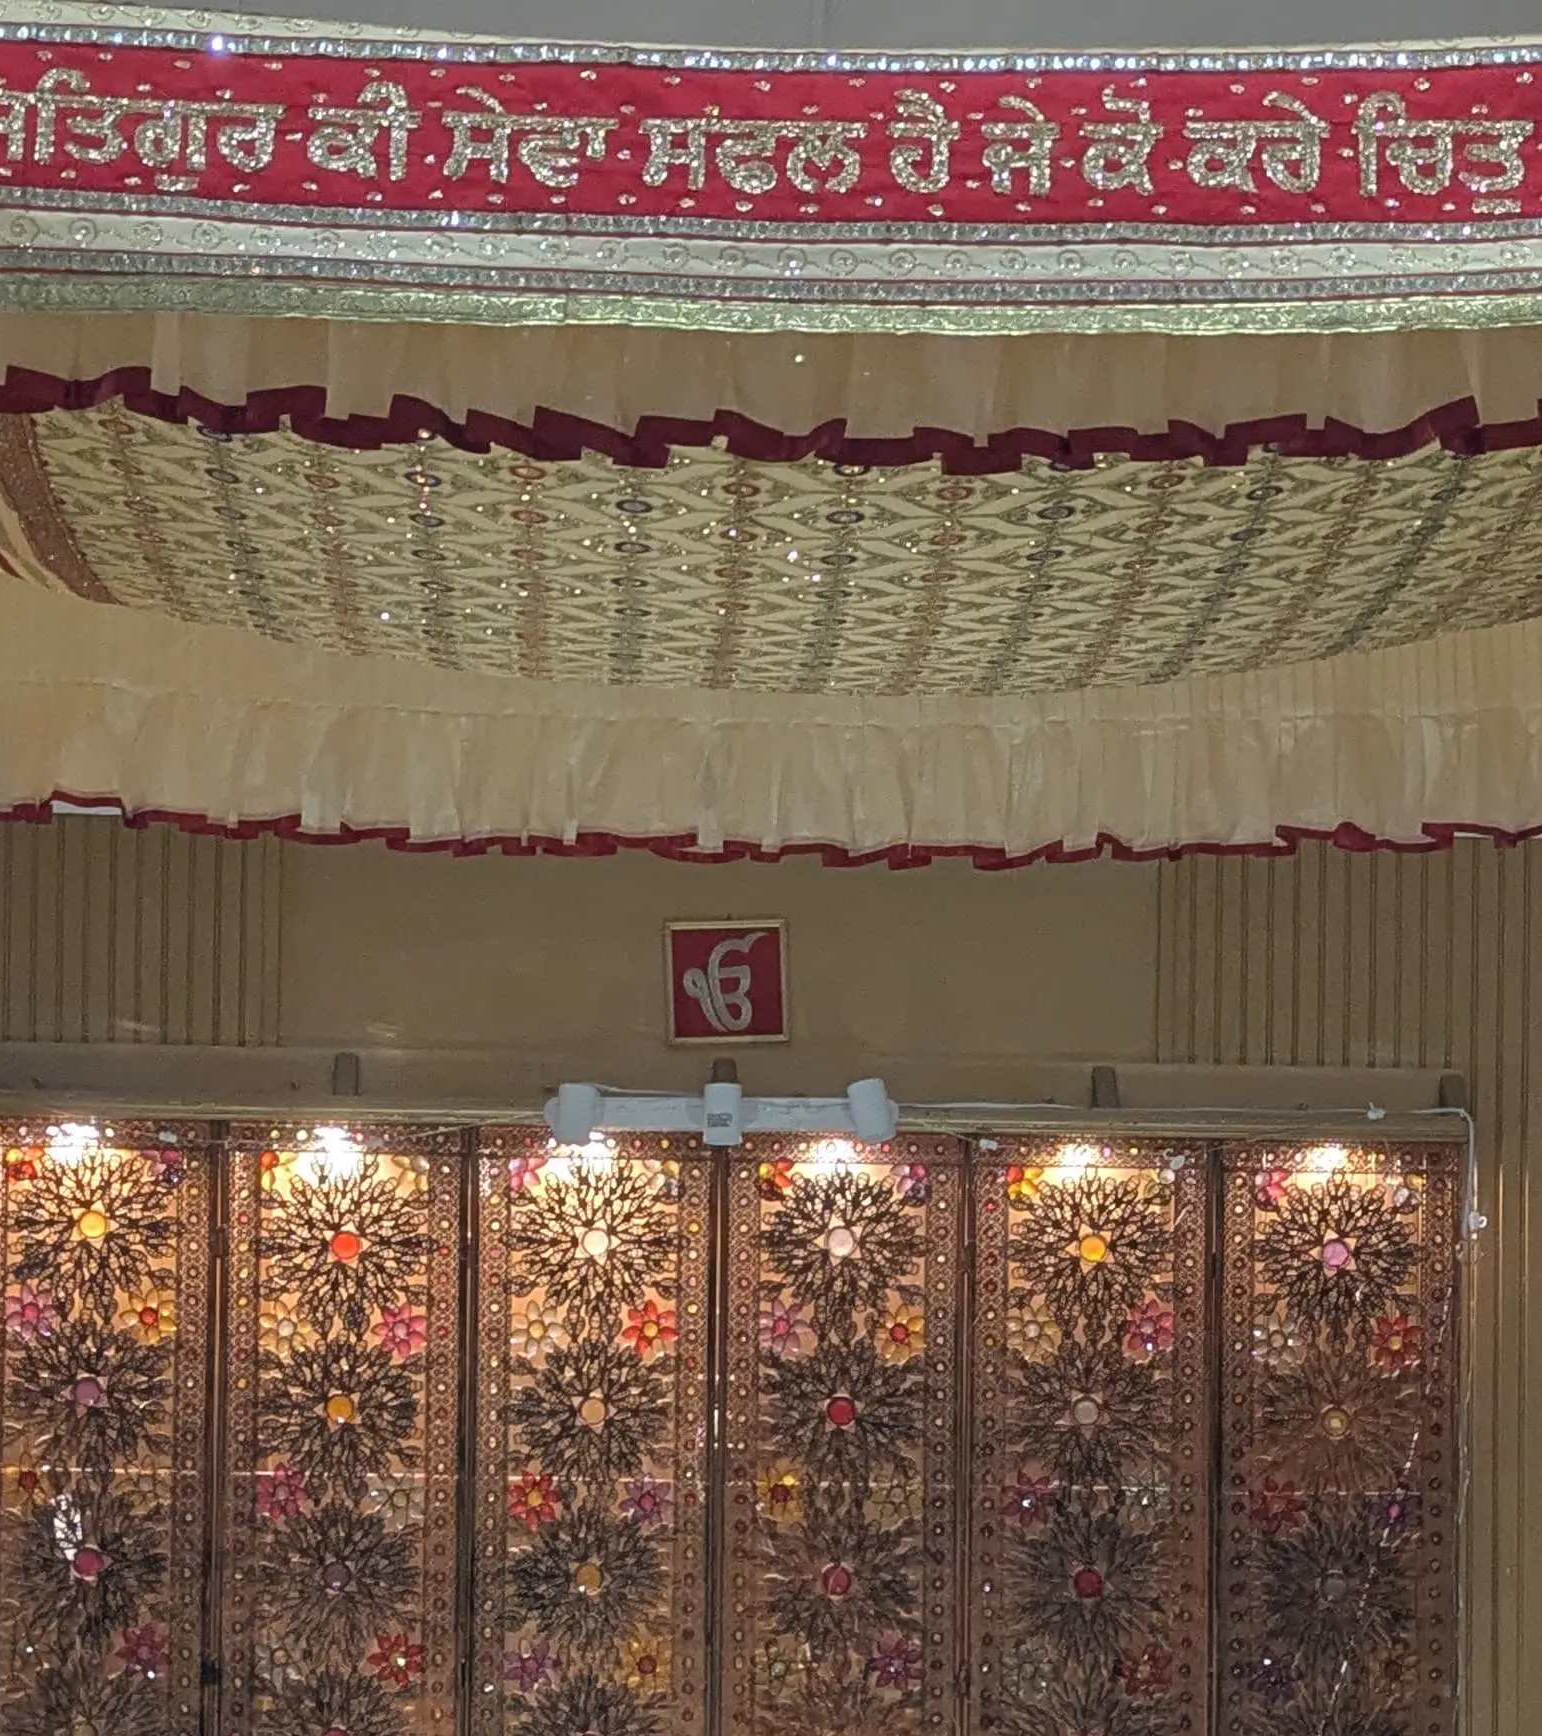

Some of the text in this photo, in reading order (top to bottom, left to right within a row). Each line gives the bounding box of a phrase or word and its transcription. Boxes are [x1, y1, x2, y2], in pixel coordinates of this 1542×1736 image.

[306, 81, 422, 182] ਕੀ
[441, 84, 619, 188] ਸੇਵਾ
[639, 116, 867, 194] ਸਫਲ
[886, 88, 961, 194] ਹੈ
[981, 95, 1061, 197] ਜੇ
[1183, 91, 1331, 194] ਕਰੇ
[1351, 90, 1534, 213] ਚਿਤੁ
